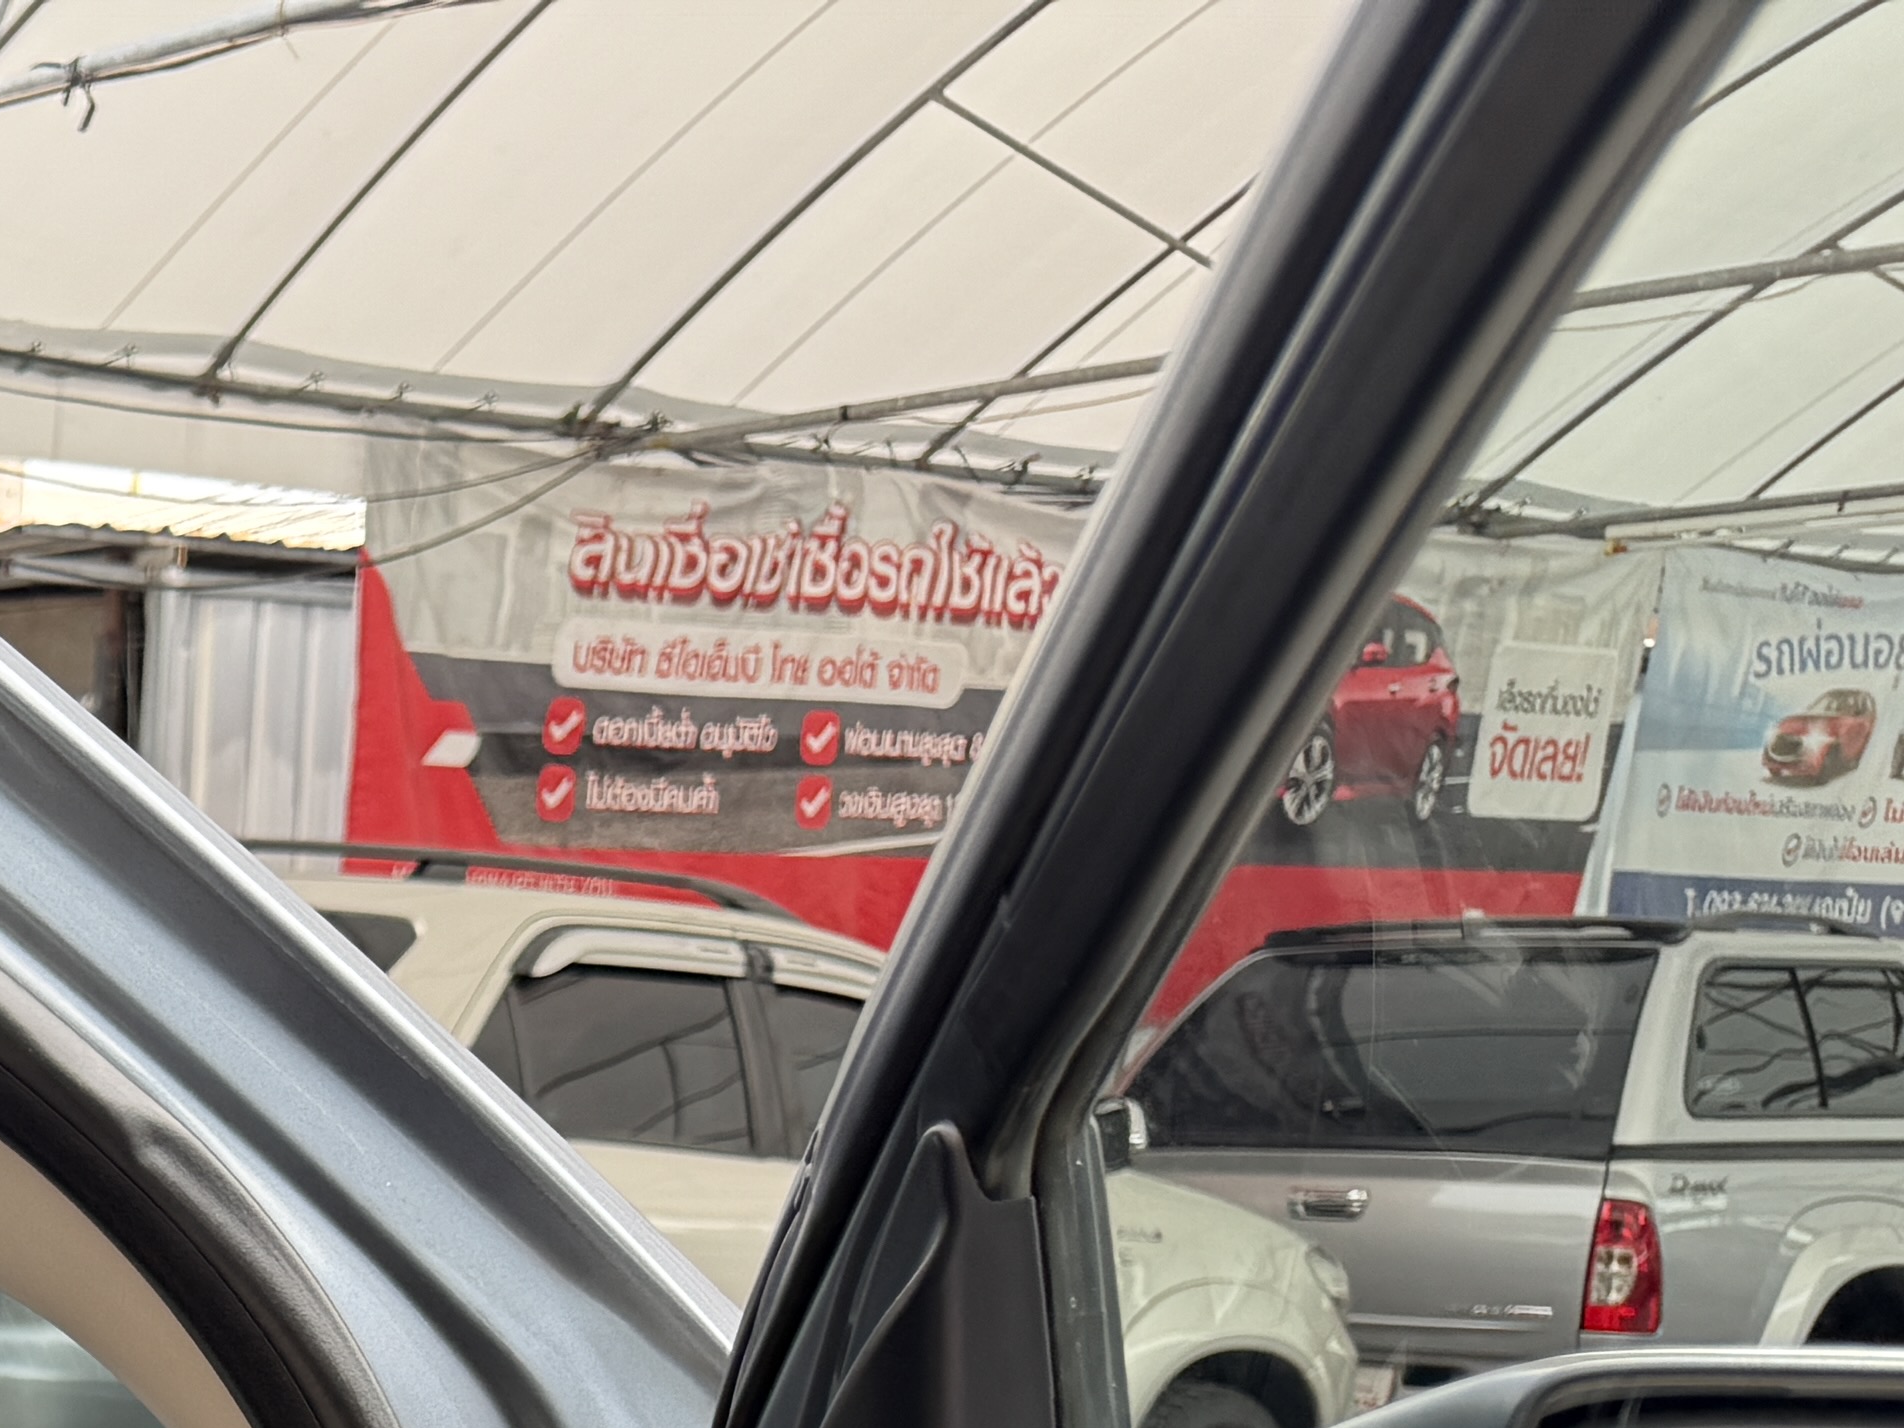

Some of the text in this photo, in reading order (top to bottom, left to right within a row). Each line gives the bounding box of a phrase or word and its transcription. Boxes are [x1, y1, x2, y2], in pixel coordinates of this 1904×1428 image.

[573, 633, 648, 676] บริษัท
[1490, 719, 1592, 783] จัดเลย!
